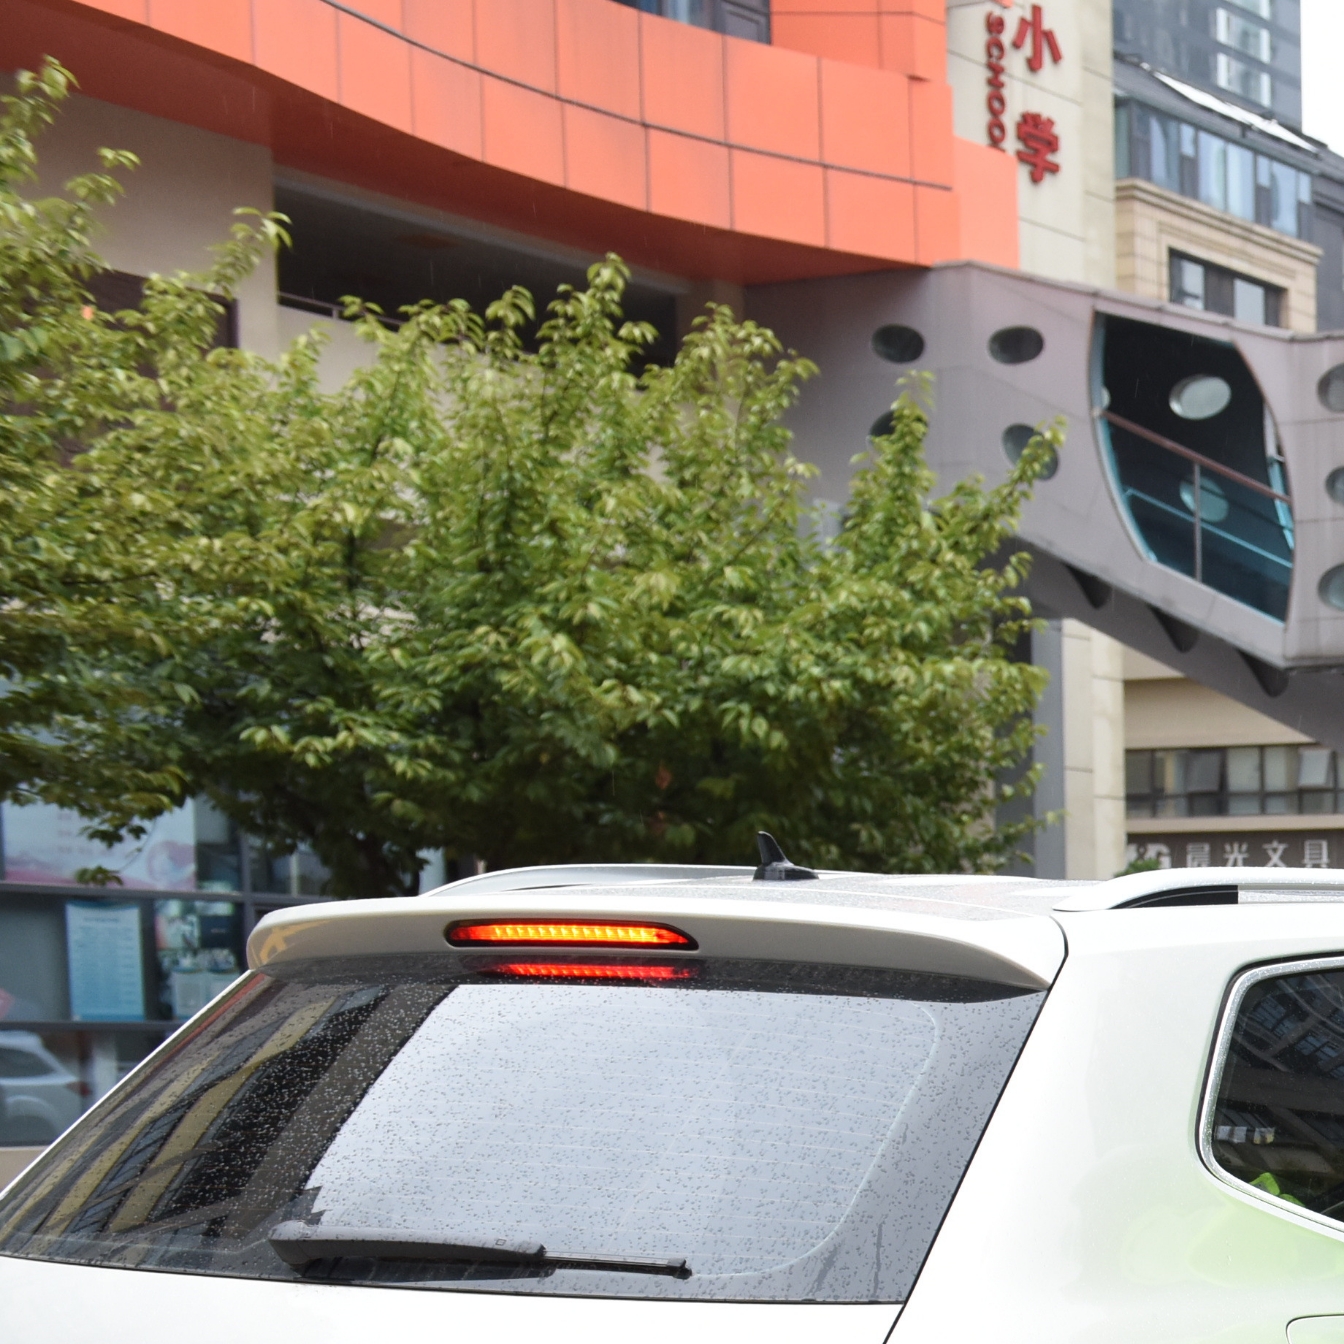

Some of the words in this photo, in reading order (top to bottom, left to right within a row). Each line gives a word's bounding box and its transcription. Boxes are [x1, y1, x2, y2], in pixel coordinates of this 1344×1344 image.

[1012, 4, 1062, 184] 小学
[1186, 839, 1330, 869] 晨光文具
